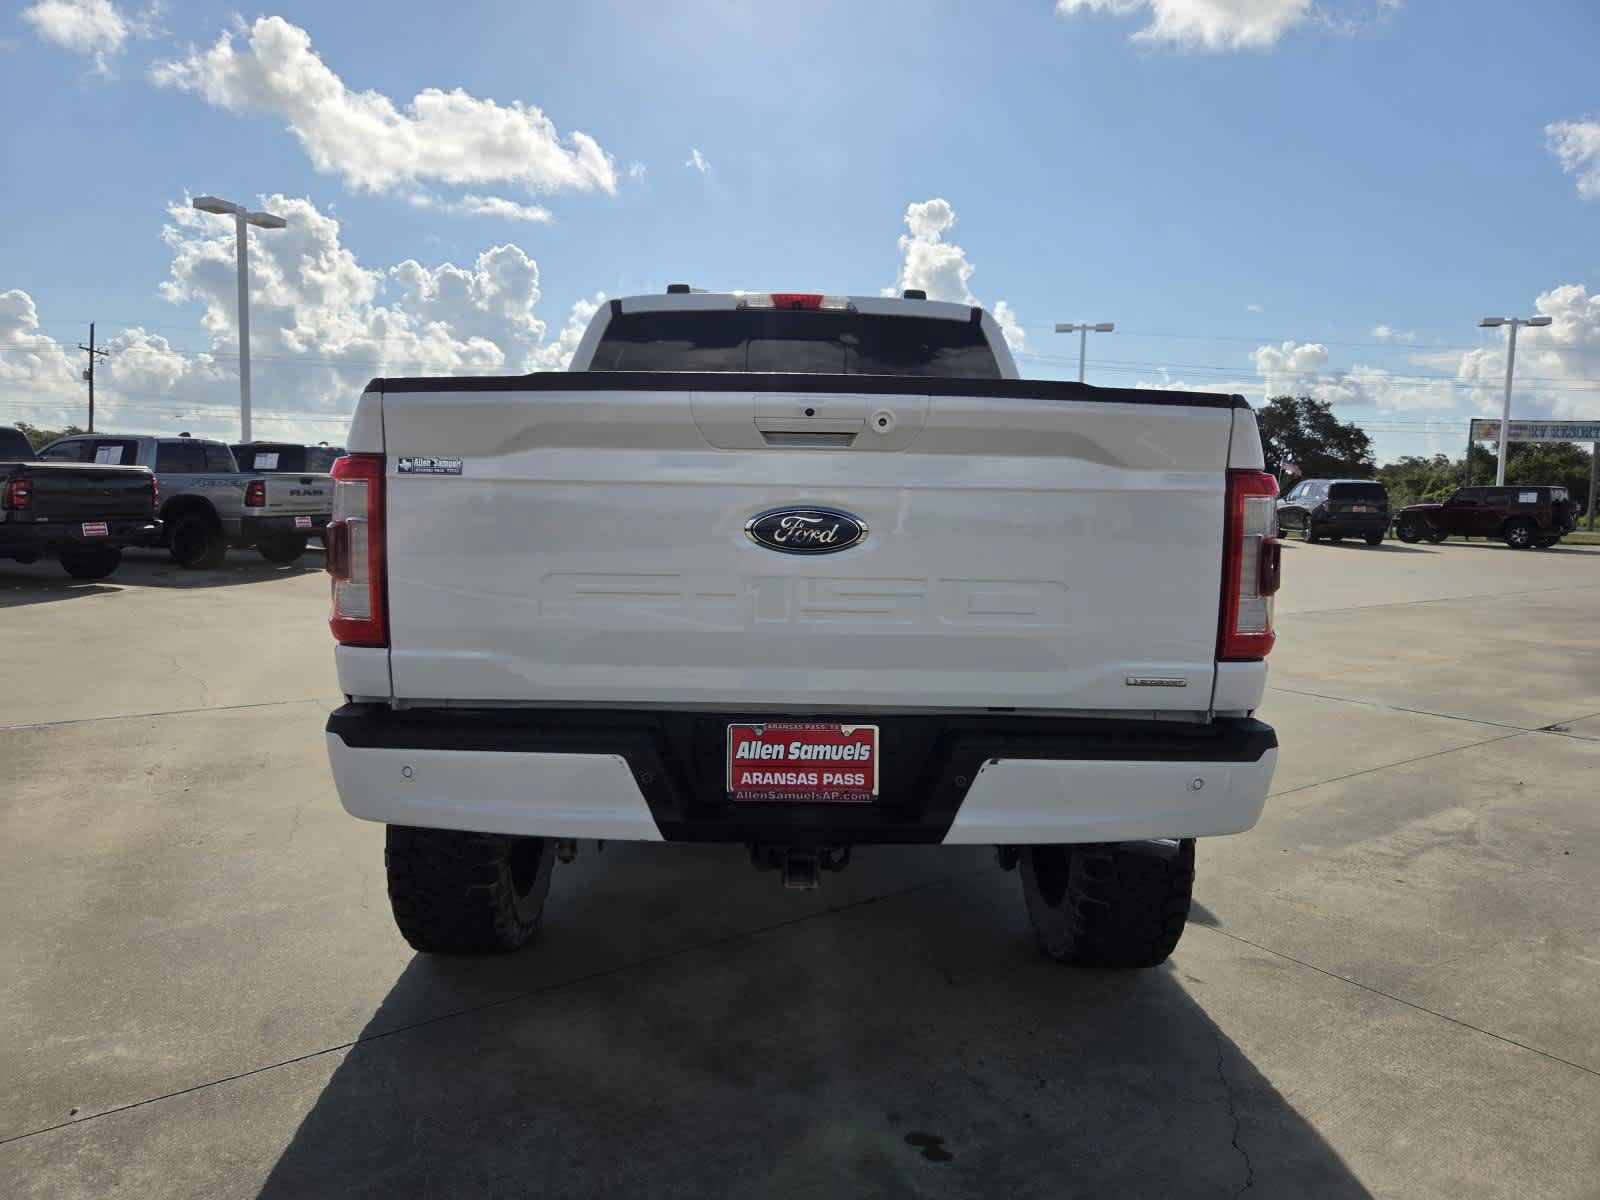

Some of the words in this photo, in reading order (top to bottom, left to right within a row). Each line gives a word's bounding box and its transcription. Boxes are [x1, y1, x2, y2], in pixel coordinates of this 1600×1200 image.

[290, 488, 323, 497] RAM
[774, 515, 839, 545] Ford
[736, 740, 785, 760] Allen
[788, 741, 871, 761] Samuels
[741, 772, 818, 785] ARANSAS
[823, 773, 865, 785] PASS
[736, 790, 870, 801] AllenSamuelsAP.com
